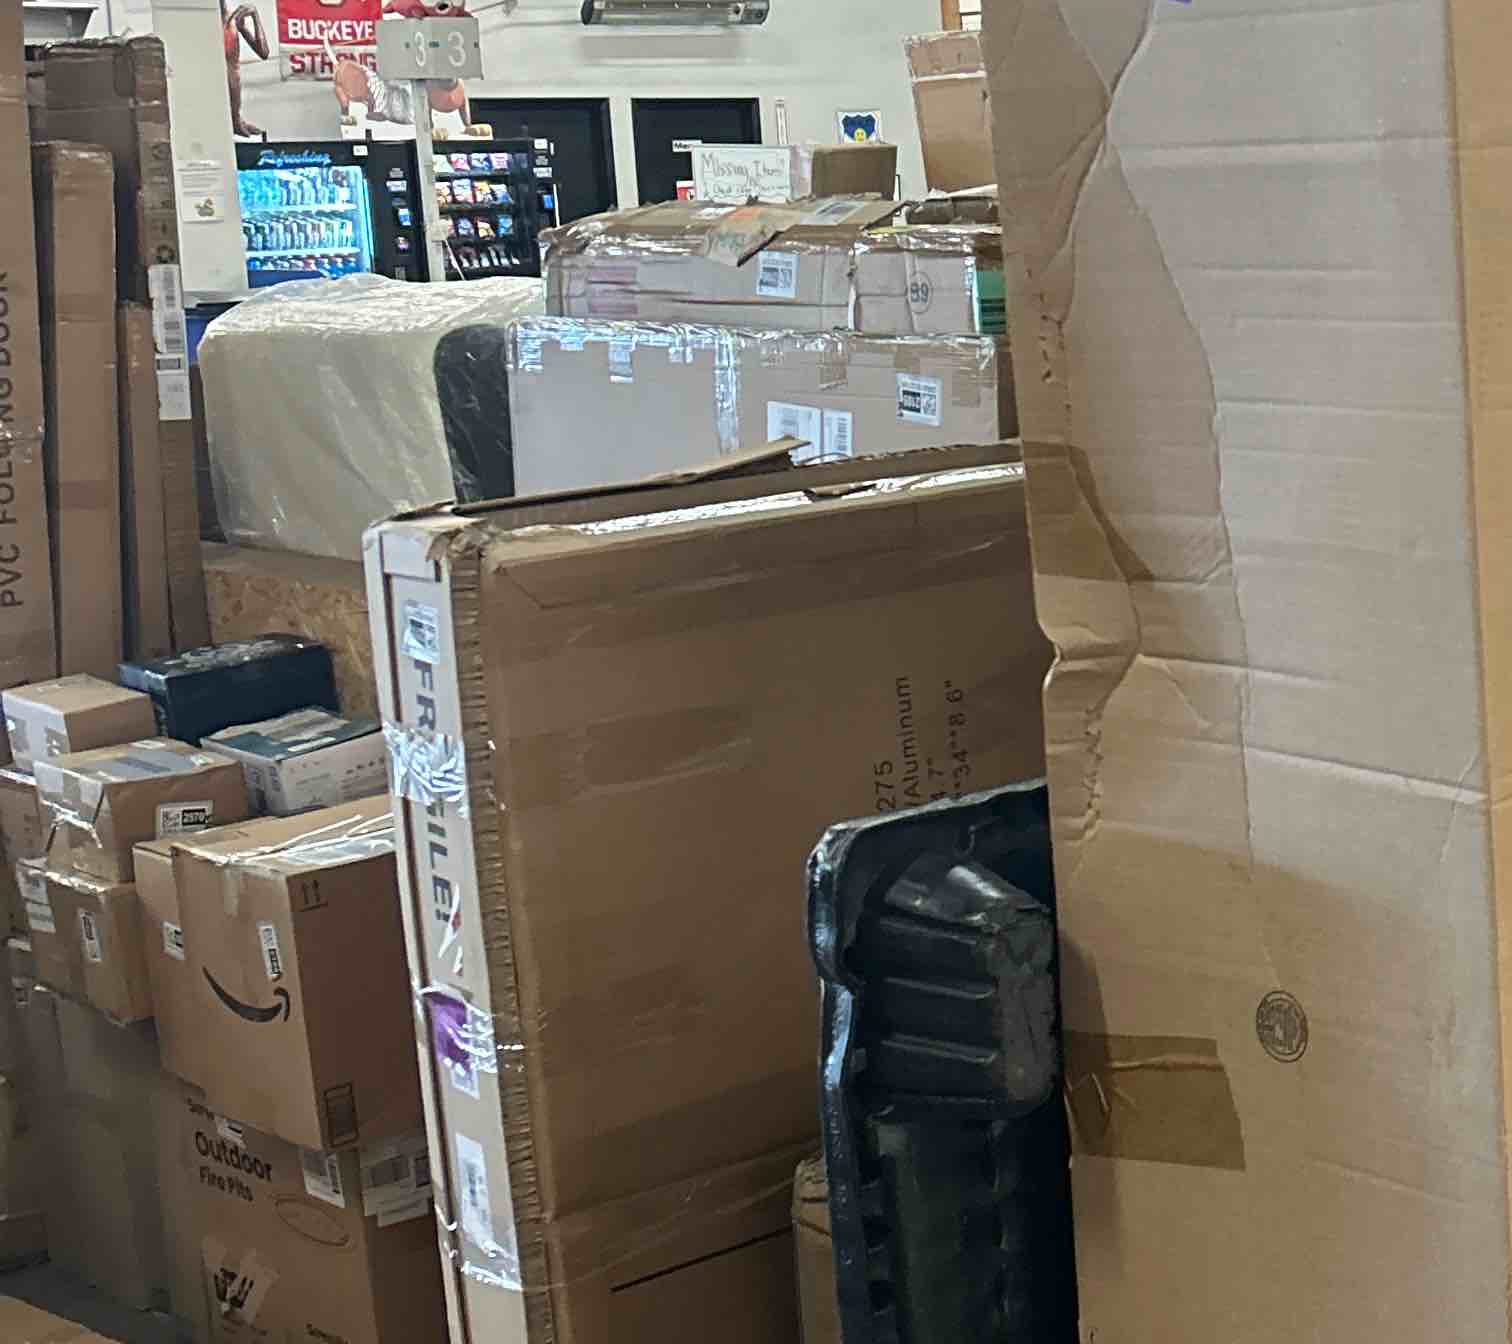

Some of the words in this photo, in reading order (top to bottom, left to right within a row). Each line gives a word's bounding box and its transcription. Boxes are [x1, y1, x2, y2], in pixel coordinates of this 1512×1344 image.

[287, 18, 375, 41] BUCKEYE
[447, 31, 467, 68] 3
[0, 543, 23, 608] PVC
[194, 1131, 273, 1182] Outdoor
[199, 1166, 227, 1192] Fire
